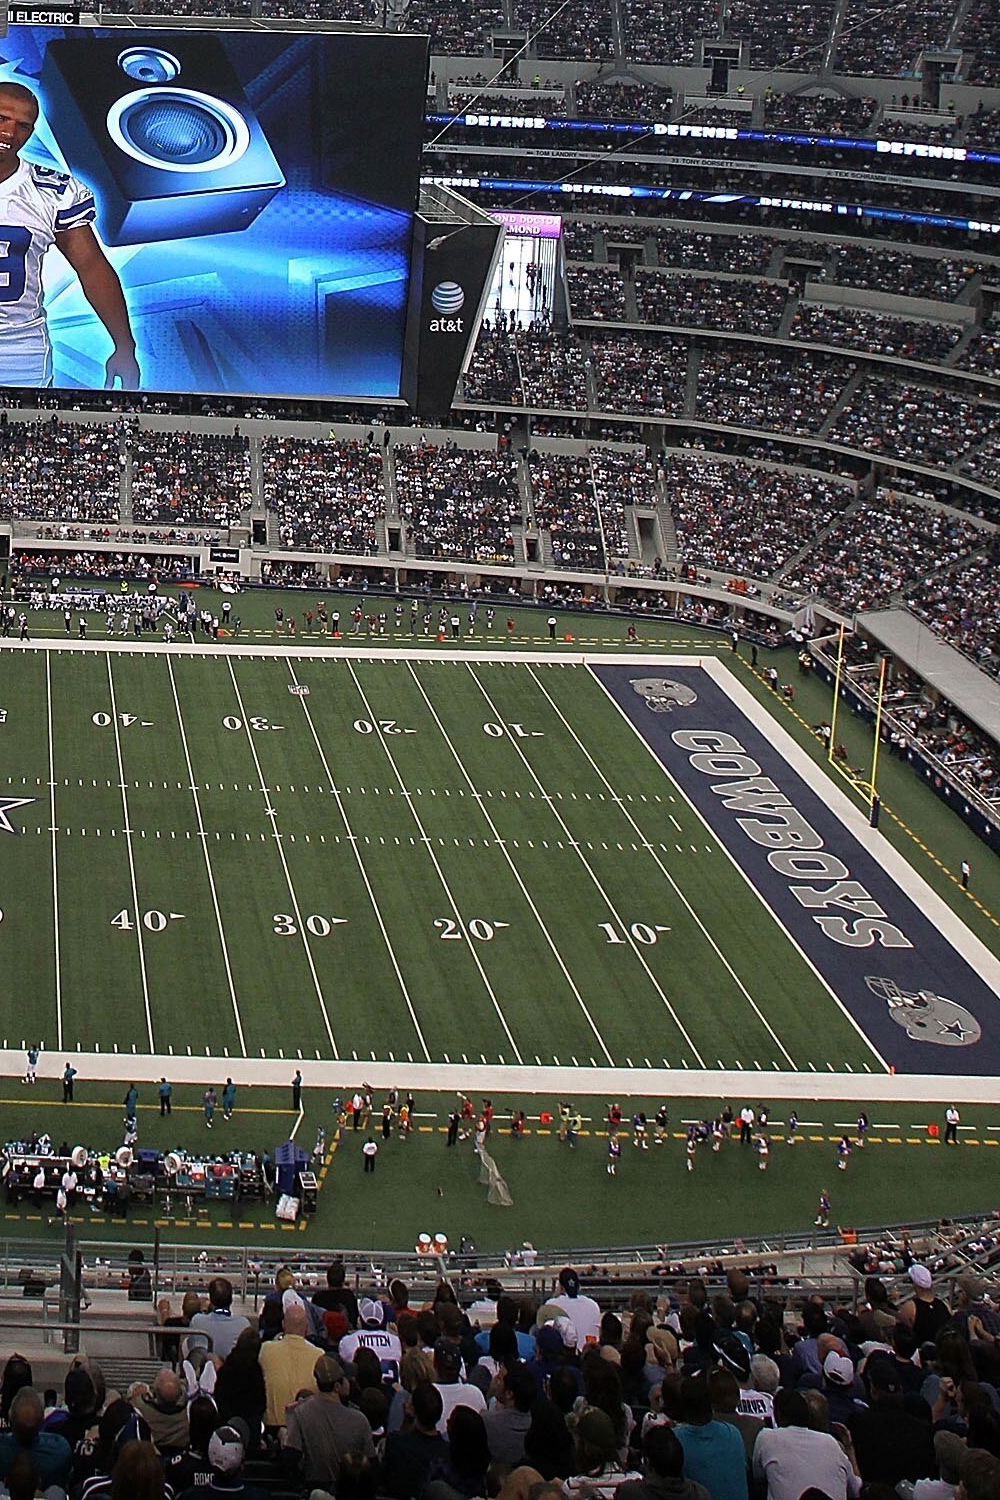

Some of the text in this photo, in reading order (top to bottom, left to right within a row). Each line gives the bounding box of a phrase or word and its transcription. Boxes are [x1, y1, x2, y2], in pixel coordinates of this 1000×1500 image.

[16, 11, 74, 24] ELECTRIC
[465, 114, 546, 129] DEFENSE
[653, 123, 739, 141] DEFENSE
[876, 140, 968, 161] DEFENSE
[759, 196, 833, 213] DEFENSE
[520, 215, 560, 226] DOCTOR
[508, 224, 542, 235] MOND
[429, 316, 464, 333] at&t
[670, 729, 915, 949] COWBOYS
[110, 908, 168, 933] 40
[272, 913, 332, 938] 30
[433, 917, 495, 942] 20
[598, 921, 658, 946] 10
[357, 1334, 391, 1348] WITTEN
